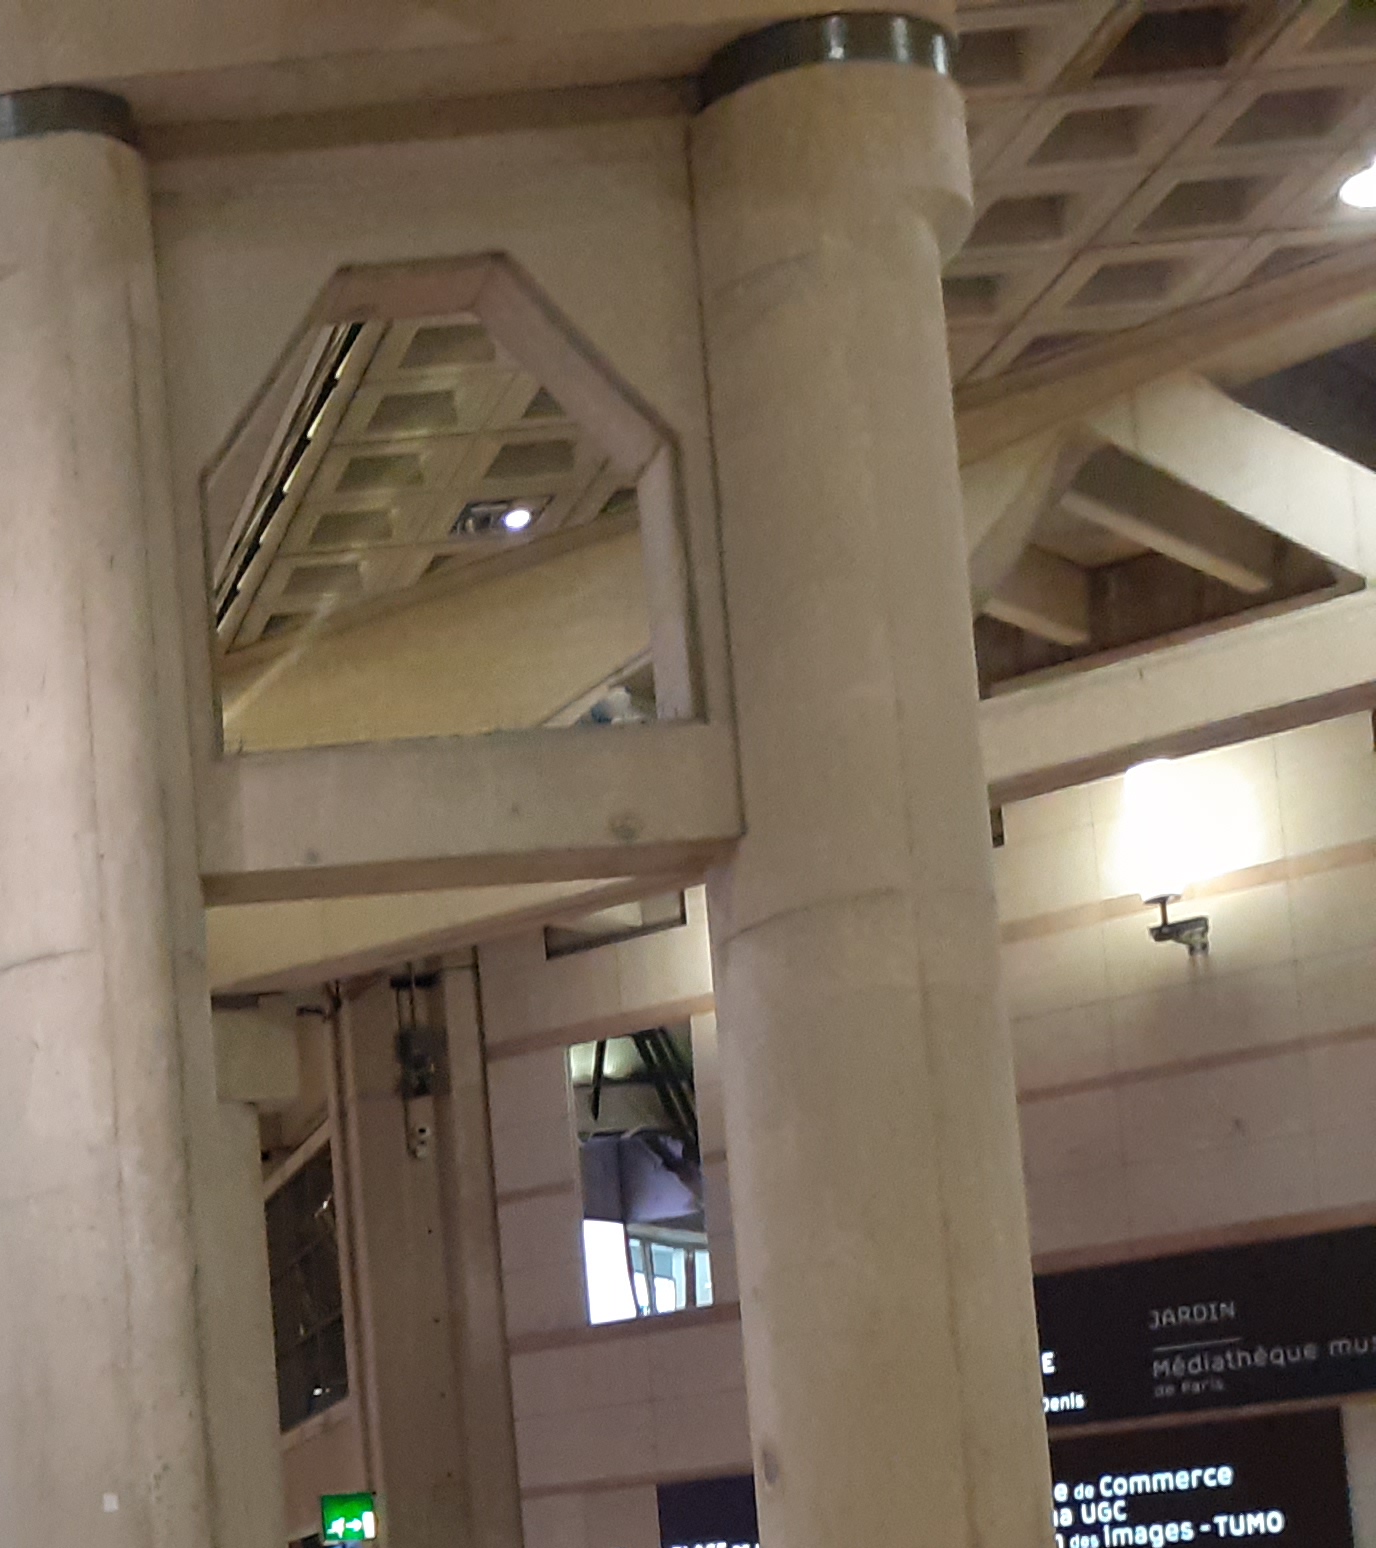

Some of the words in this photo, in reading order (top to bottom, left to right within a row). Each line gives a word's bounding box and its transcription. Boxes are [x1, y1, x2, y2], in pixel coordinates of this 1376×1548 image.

[1150, 1301, 1237, 1330] JARDIN
[1073, 1482, 1095, 1500] de
[1099, 1465, 1233, 1498] Commerce
[1080, 1499, 1127, 1525] UGC
[1103, 1521, 1195, 1548] Images
[1213, 1510, 1285, 1537] TUMO
